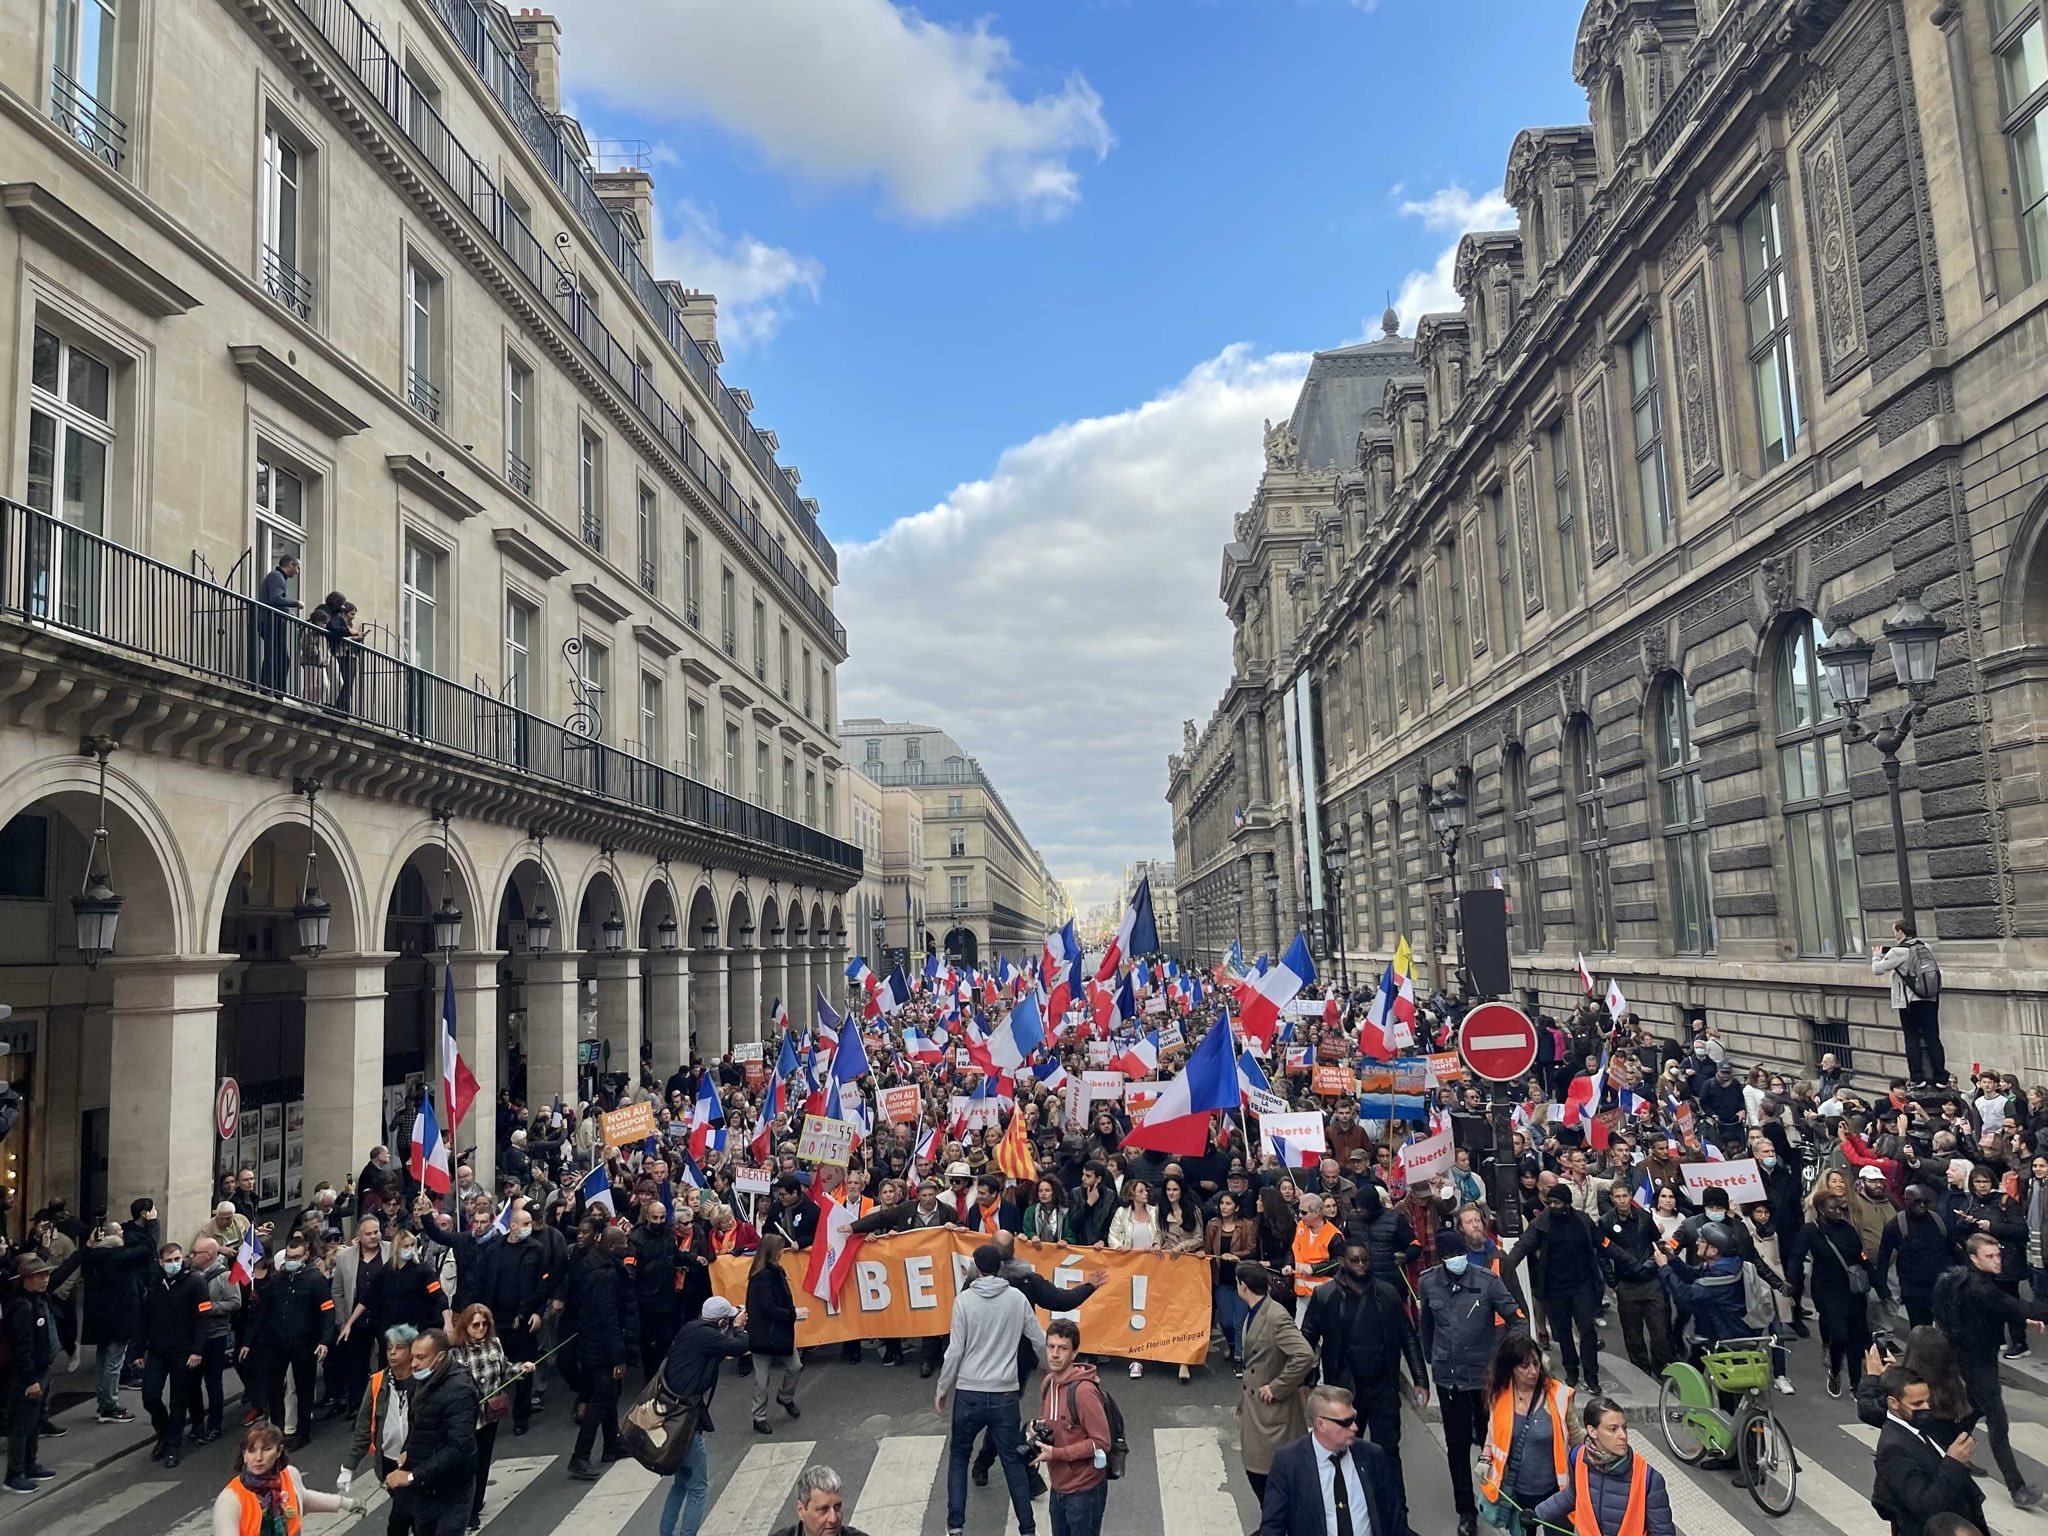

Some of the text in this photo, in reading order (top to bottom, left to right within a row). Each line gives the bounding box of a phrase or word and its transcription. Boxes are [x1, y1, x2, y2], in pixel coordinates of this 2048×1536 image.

[606, 1115, 650, 1133] PASSEPORT
[607, 1106, 647, 1124] NON AU
[611, 1124, 647, 1139] SANITAIRE
[1264, 1125, 1312, 1137] Liberté
[1408, 1145, 1448, 1168] Liberté
[1689, 1174, 1747, 1188] Liberté
[1128, 1330, 1204, 1354] Avec Florian Philippot
